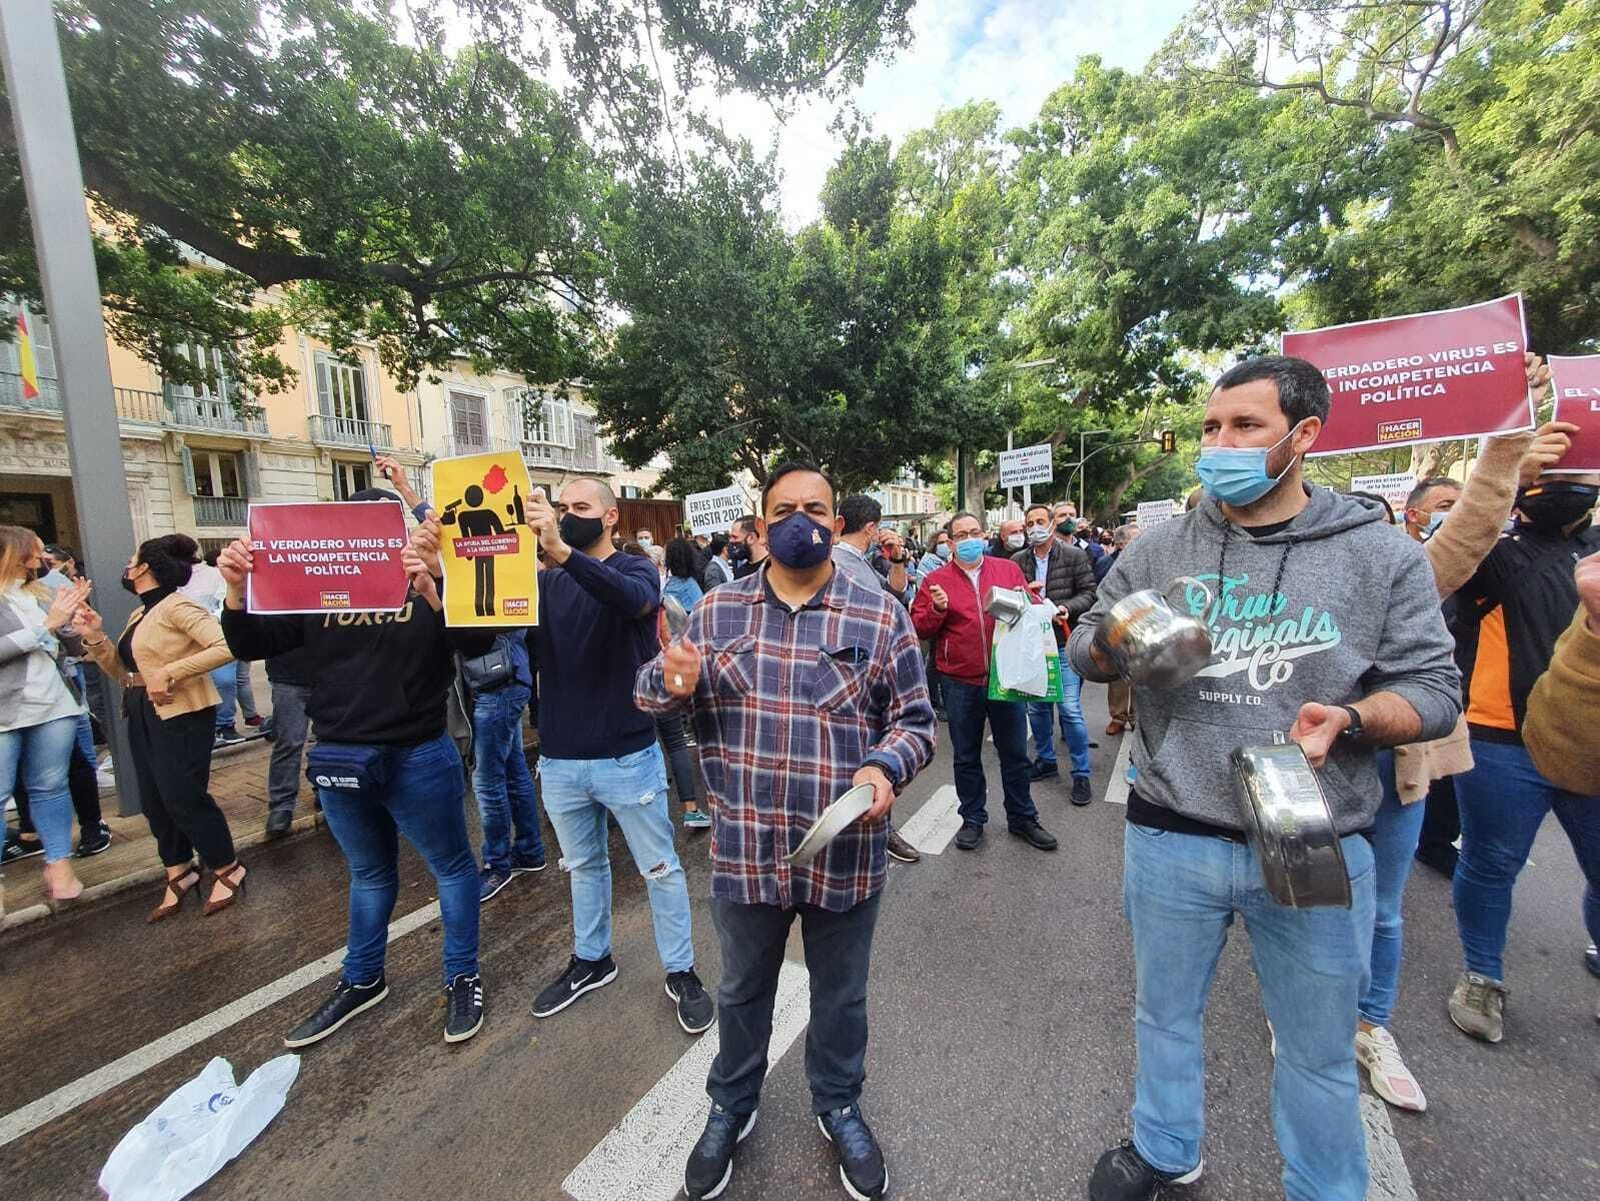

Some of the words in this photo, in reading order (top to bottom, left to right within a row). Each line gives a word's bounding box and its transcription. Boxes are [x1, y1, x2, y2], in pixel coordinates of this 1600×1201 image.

[1429, 346, 1487, 363] VIRUS
[1492, 341, 1518, 355] ES
[1339, 360, 1495, 393] INCOMPETENCIA
[1360, 382, 1446, 405] POLÍTICA
[1564, 388, 1589, 398] EL
[1590, 400, 1600, 411] L
[1385, 422, 1419, 432] HACER
[1380, 429, 1420, 441] NACIÓN
[1002, 464, 1050, 477] IMPROVISACIÓN
[690, 500, 711, 513] ERTES
[712, 494, 742, 509] TOTALES
[692, 511, 722, 528] HASTA
[722, 507, 744, 522] 2021
[252, 540, 267, 550] EL
[270, 539, 345, 550] VERDADERO
[348, 538, 385, 548] VIRUS
[388, 538, 403, 548] ES
[268, 554, 286, 563] LA
[288, 552, 390, 563] INCOMPETENCIA
[305, 563, 362, 575] POLÍTICA
[1185, 573, 1288, 631] True
[1211, 607, 1341, 664] iginals
[1248, 640, 1294, 691] Co
[1199, 690, 1242, 705] SUPPLY
